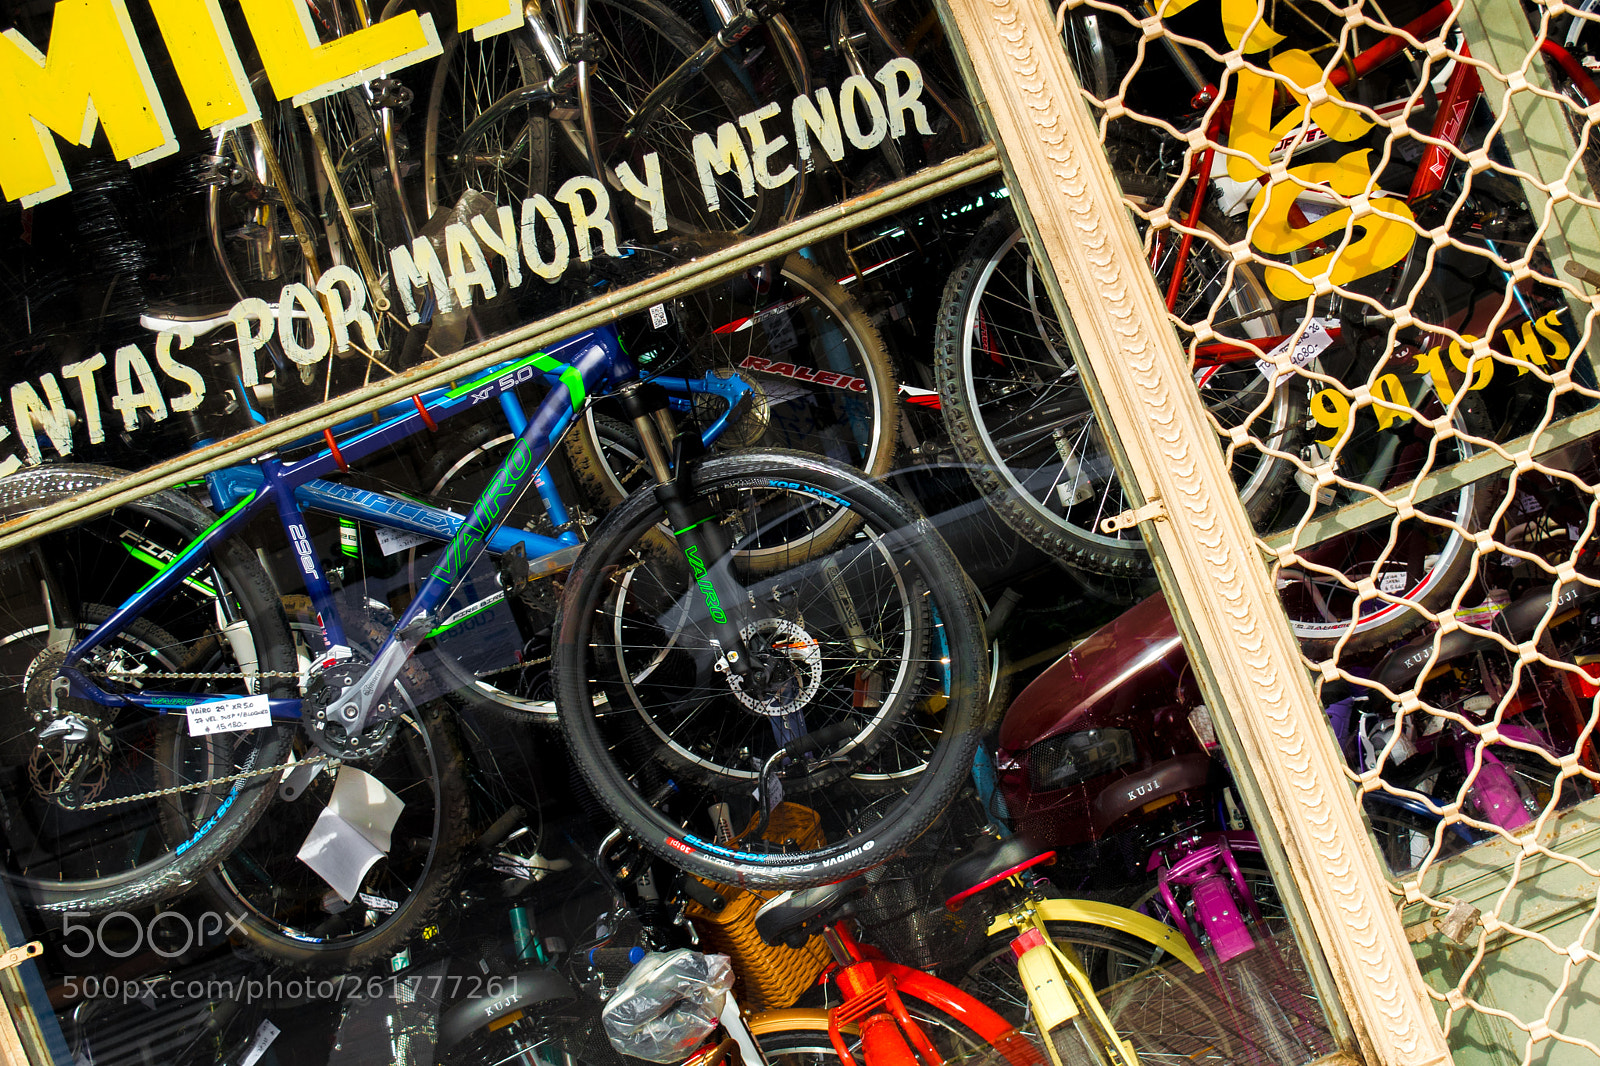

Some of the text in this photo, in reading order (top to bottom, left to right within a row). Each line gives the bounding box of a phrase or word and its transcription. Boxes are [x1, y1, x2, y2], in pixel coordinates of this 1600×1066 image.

[0, 0, 523, 209] MIL
[0, 57, 936, 478] NTAS POR MAYOR Y MENOR
[499, 365, 534, 391] 5.0
[1310, 388, 1351, 448] 9
[1412, 334, 1495, 406] 19
[1502, 310, 1571, 377] HS
[308, 478, 465, 537] TRIPLEX
[430, 437, 533, 585] VAIRO
[768, 479, 852, 508] BLACK BOX
[288, 523, 320, 580] 29er
[684, 545, 728, 625] VAIRO
[1127, 779, 1161, 801] KUJI
[175, 786, 239, 856] BLACK BOX
[683, 833, 768, 862] BLACK BOX
[822, 846, 863, 867] INNOVA
[484, 993, 519, 1017] KUJI
